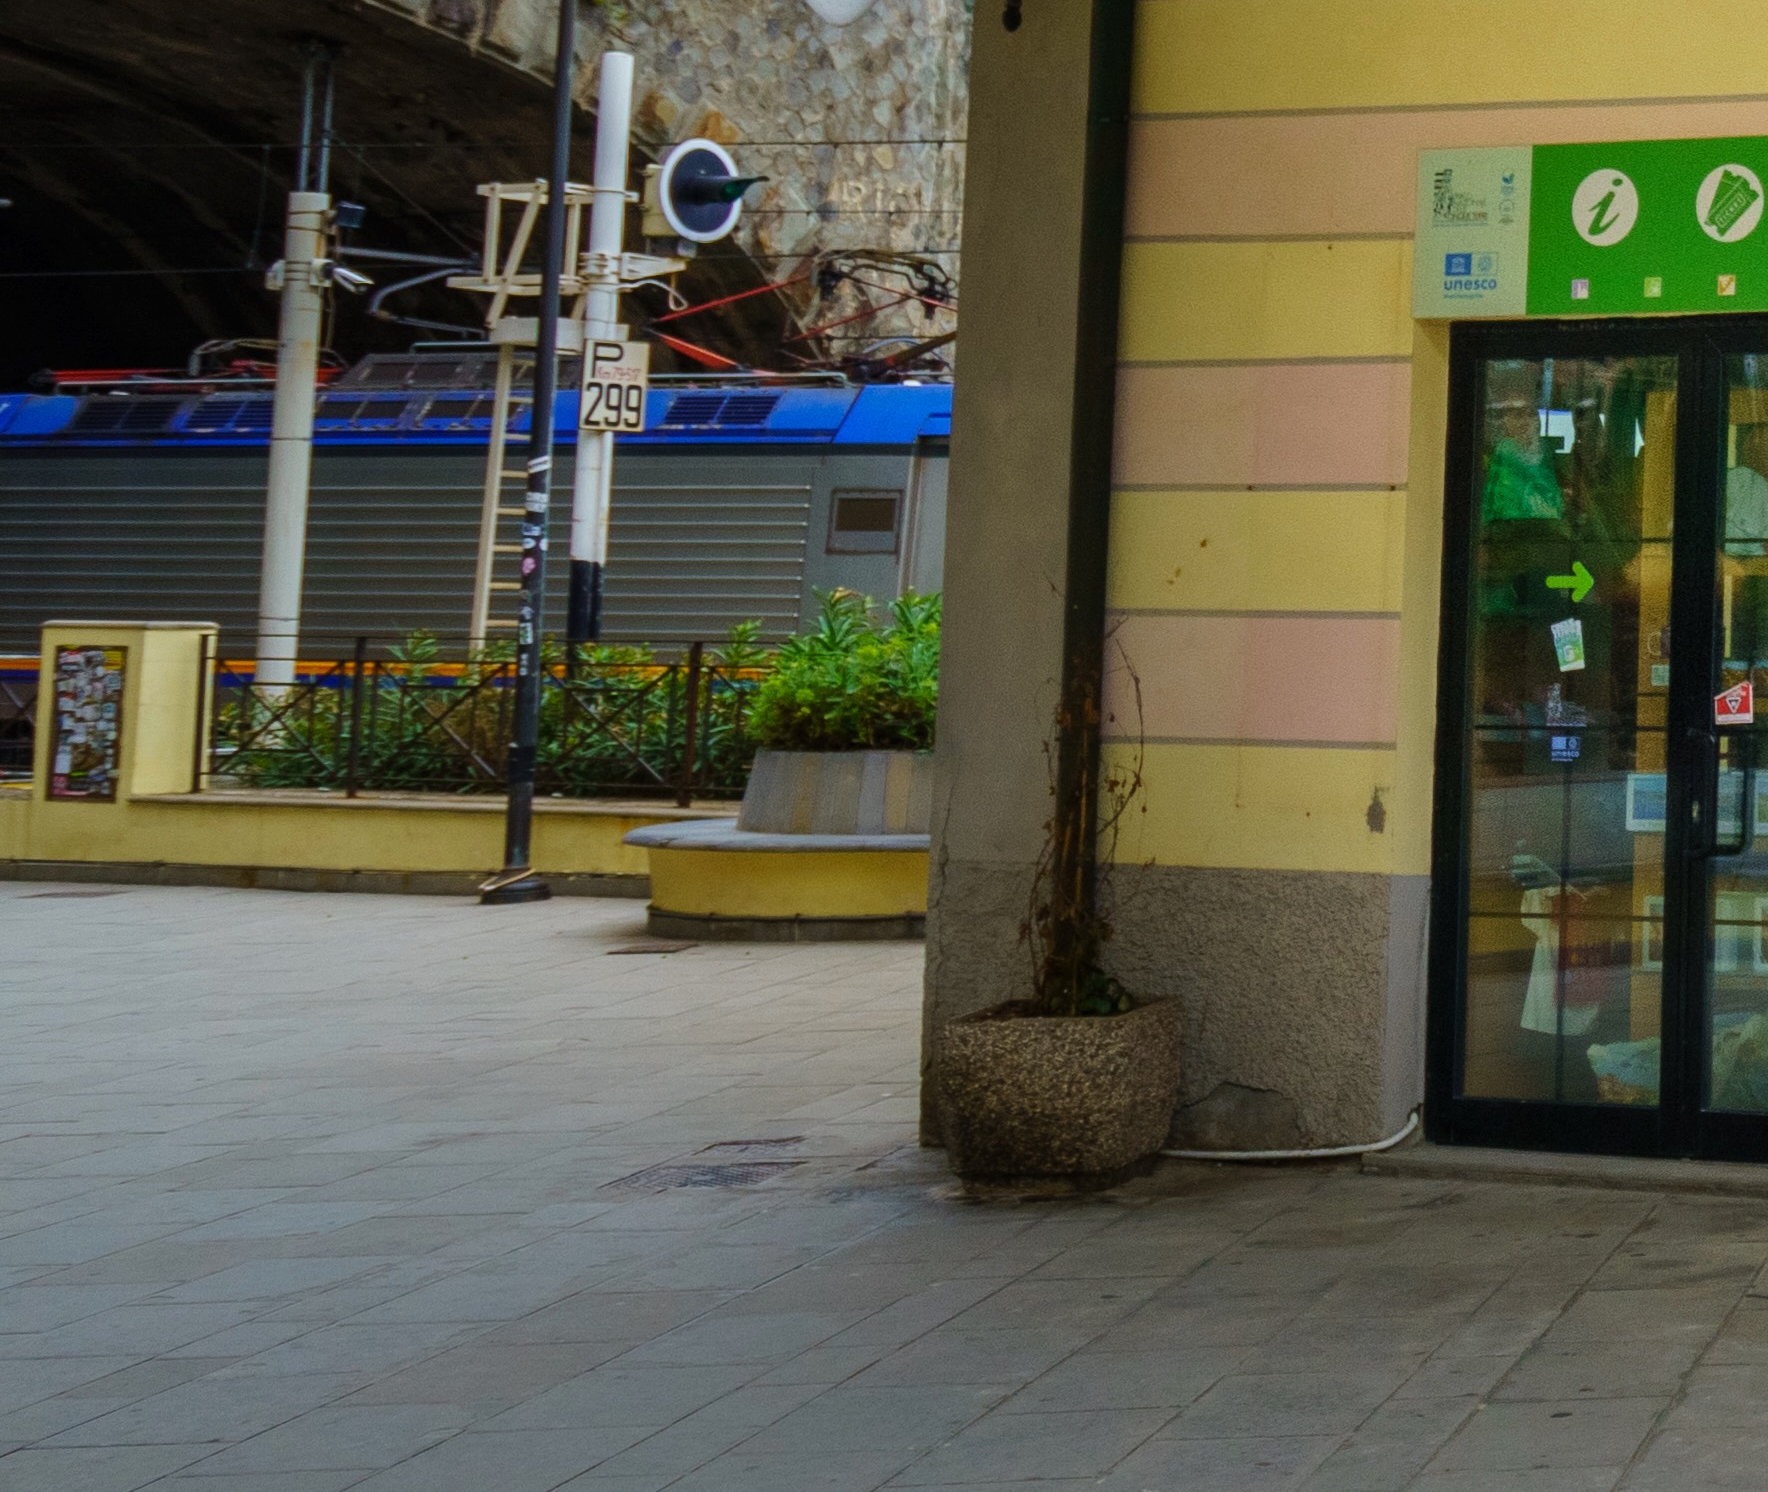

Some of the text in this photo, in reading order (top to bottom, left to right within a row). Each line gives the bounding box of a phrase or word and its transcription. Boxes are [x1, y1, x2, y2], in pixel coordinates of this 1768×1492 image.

[1444, 278, 1497, 291] unesco
[591, 342, 624, 378] P
[584, 382, 642, 428] 299
